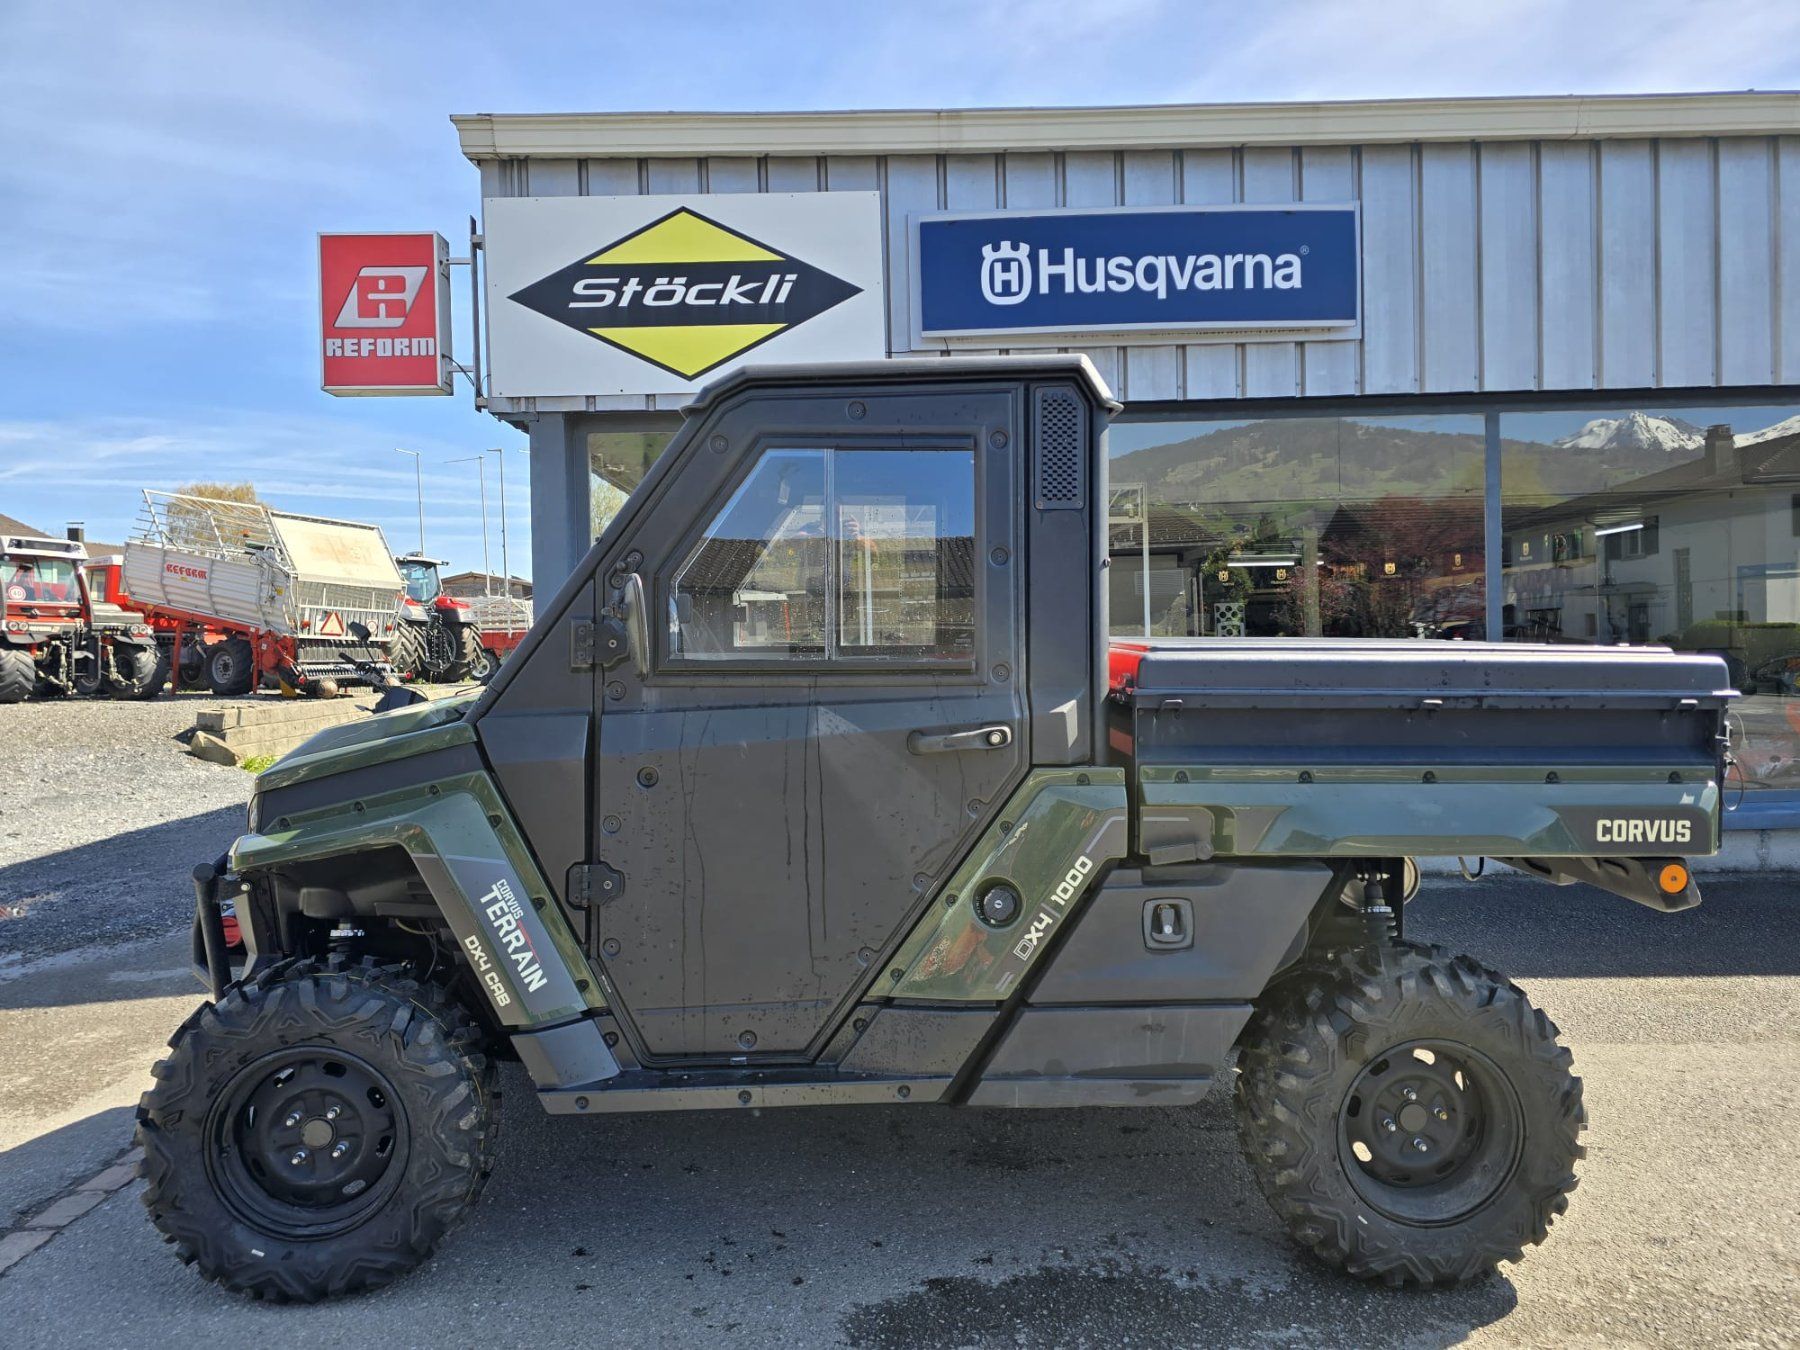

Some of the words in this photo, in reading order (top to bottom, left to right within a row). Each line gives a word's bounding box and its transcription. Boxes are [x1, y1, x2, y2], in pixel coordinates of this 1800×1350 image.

[568, 274, 798, 309] Stöckli
[1038, 247, 1303, 300] Husqvarna
[325, 337, 436, 358] REFORM
[166, 563, 208, 580] REFORM
[1596, 819, 1692, 843] CORVUS
[496, 878, 524, 920] CORVUS
[1013, 912, 1054, 961] DX4
[1050, 855, 1094, 906] 1000
[479, 883, 548, 993] TERRAIN
[464, 934, 492, 972] DX4
[484, 971, 512, 1007] CAB
